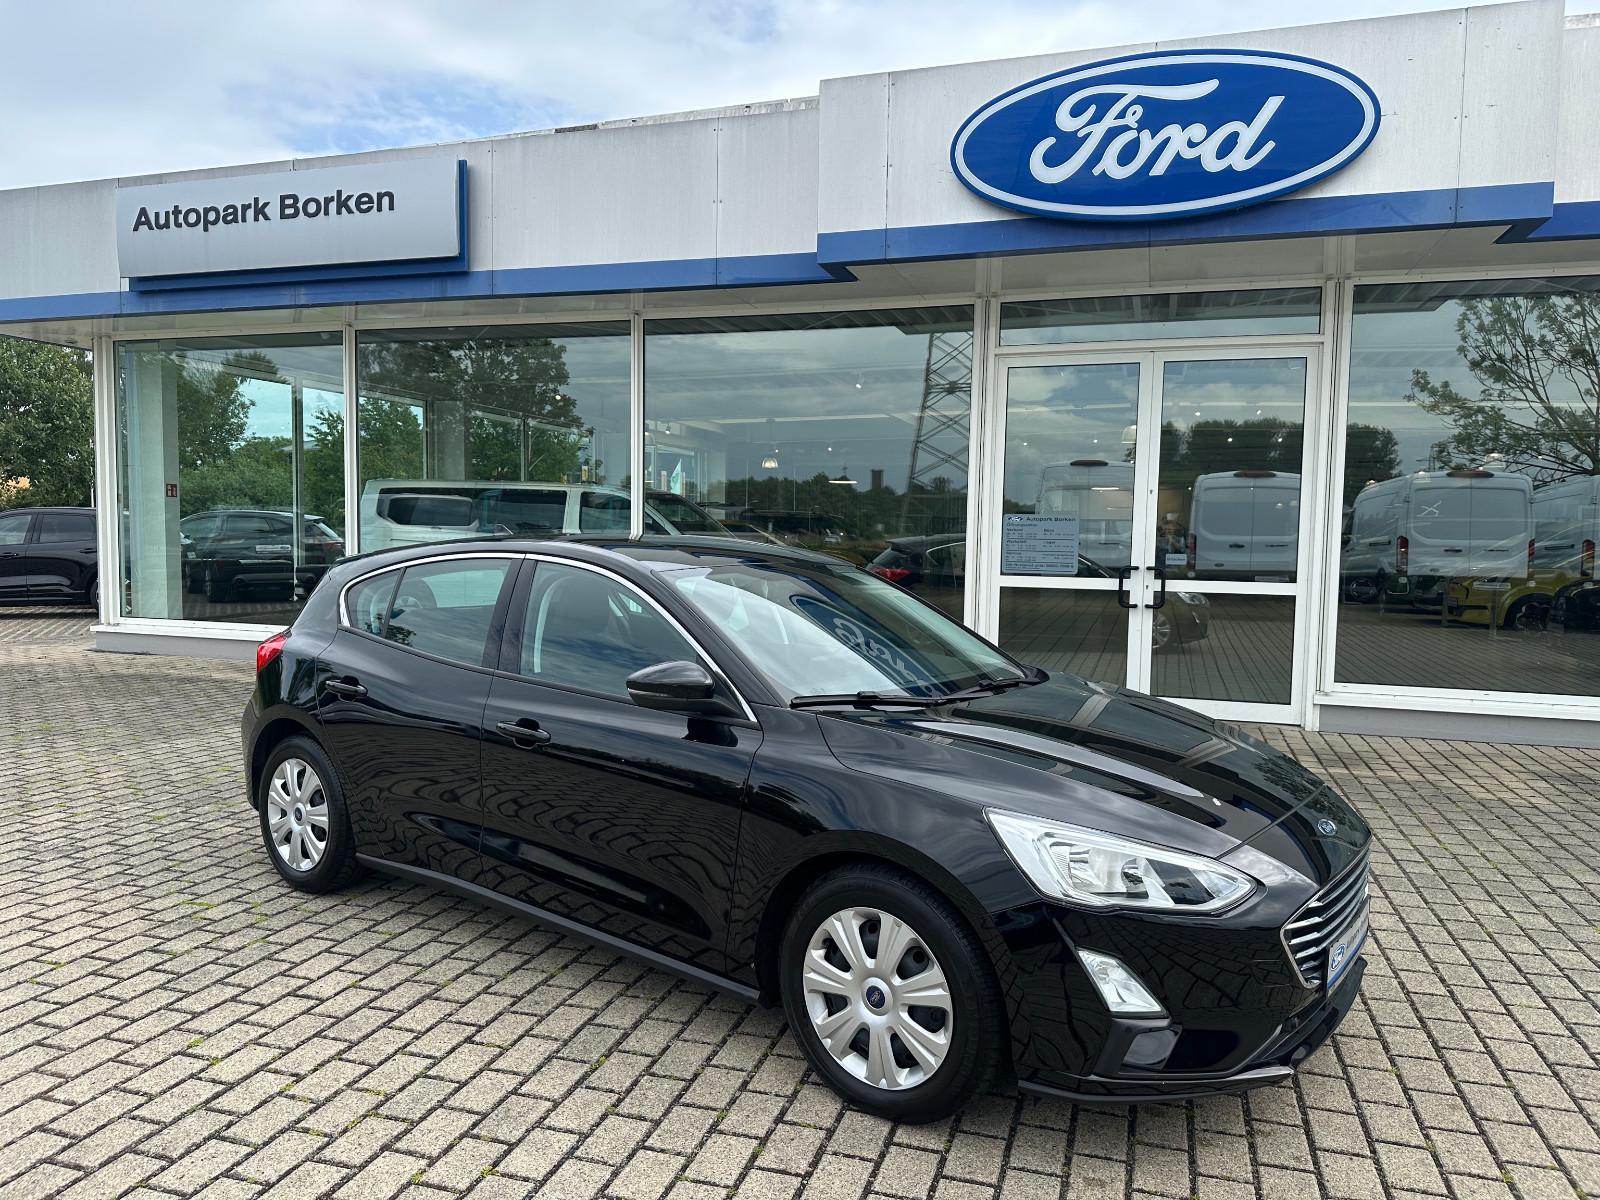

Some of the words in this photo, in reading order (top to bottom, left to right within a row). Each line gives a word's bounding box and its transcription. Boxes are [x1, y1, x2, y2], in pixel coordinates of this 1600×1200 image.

[1030, 79, 1285, 184] Ford
[132, 196, 272, 232] Autopark
[279, 190, 395, 220] Borken
